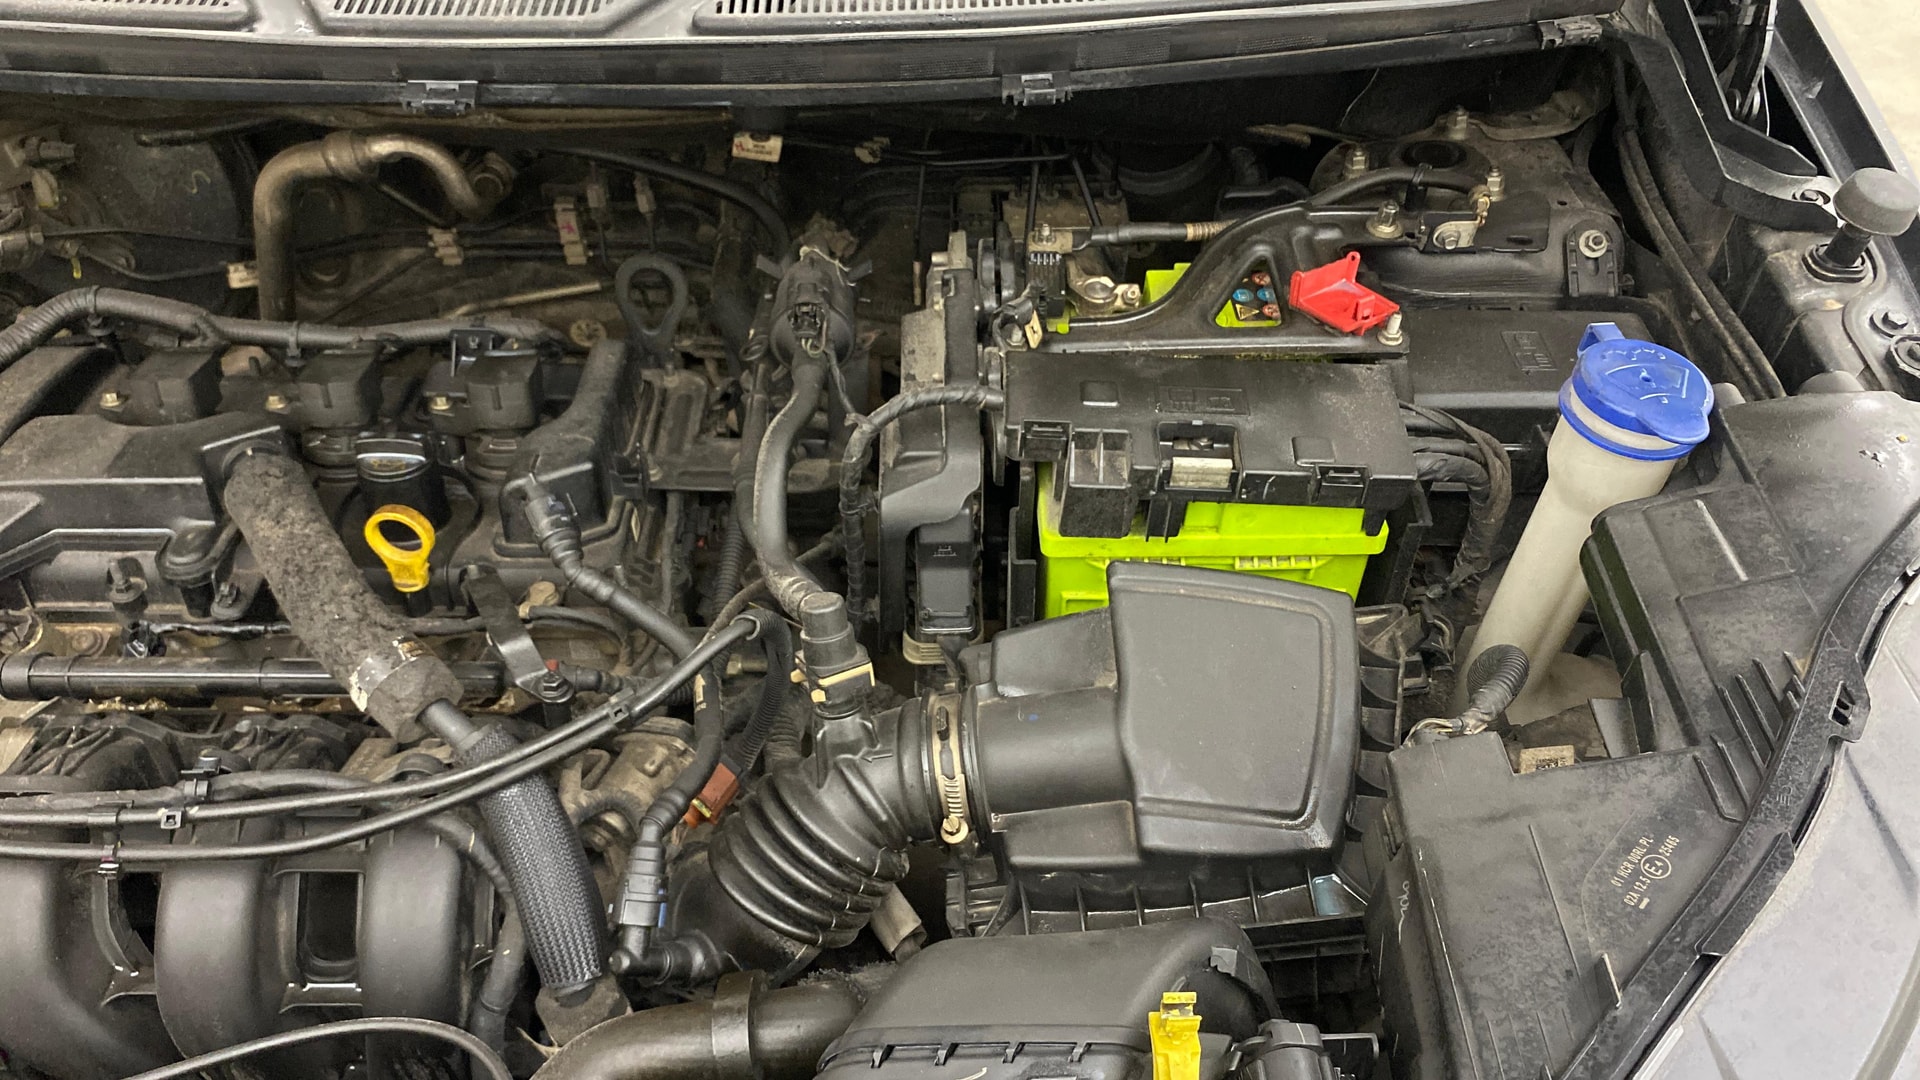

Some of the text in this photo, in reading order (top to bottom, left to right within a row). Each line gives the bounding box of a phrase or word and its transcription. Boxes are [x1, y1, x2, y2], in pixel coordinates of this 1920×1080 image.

[1616, 861, 1635, 879] HCR
[1639, 836, 1654, 847] PL
[1623, 891, 1641, 906] 02A
